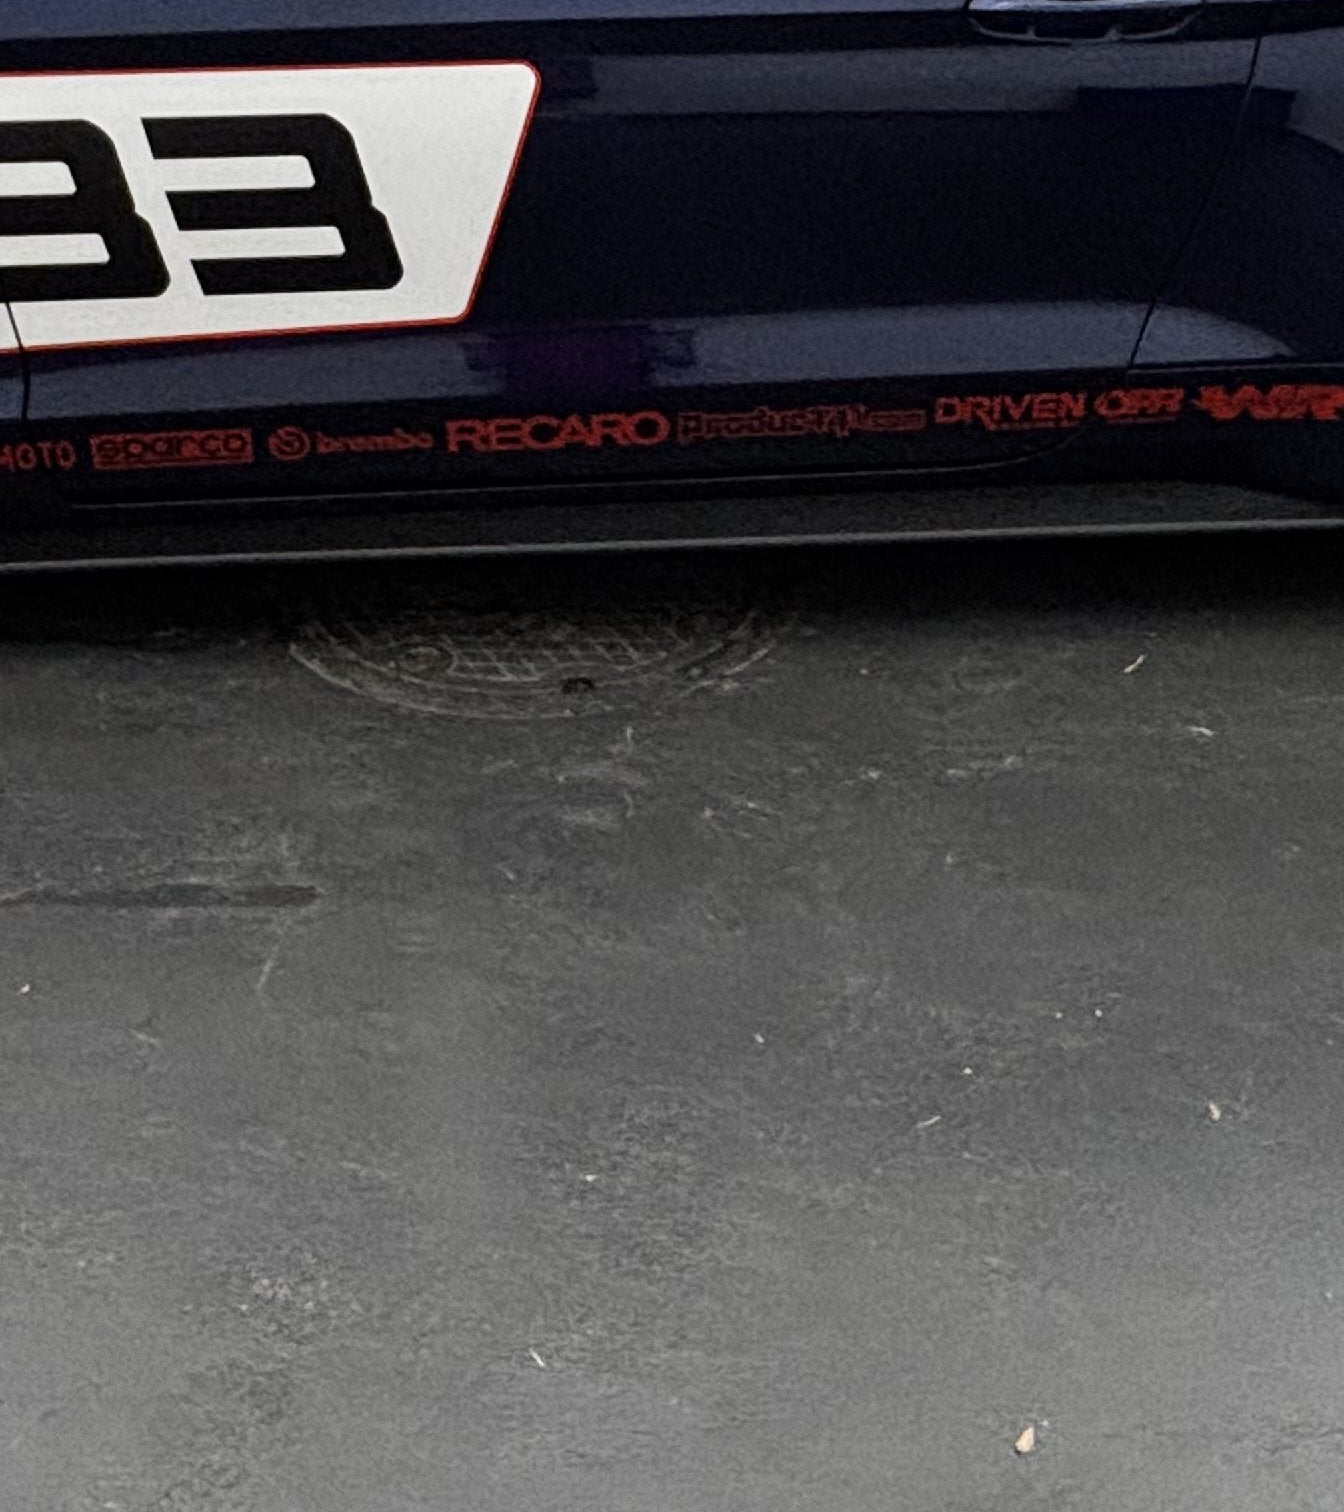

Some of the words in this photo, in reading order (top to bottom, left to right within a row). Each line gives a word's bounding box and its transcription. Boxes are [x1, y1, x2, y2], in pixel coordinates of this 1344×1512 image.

[445, 410, 670, 452] RECARO
[934, 392, 1087, 431] DRIVEN
[96, 435, 248, 465] sparco
